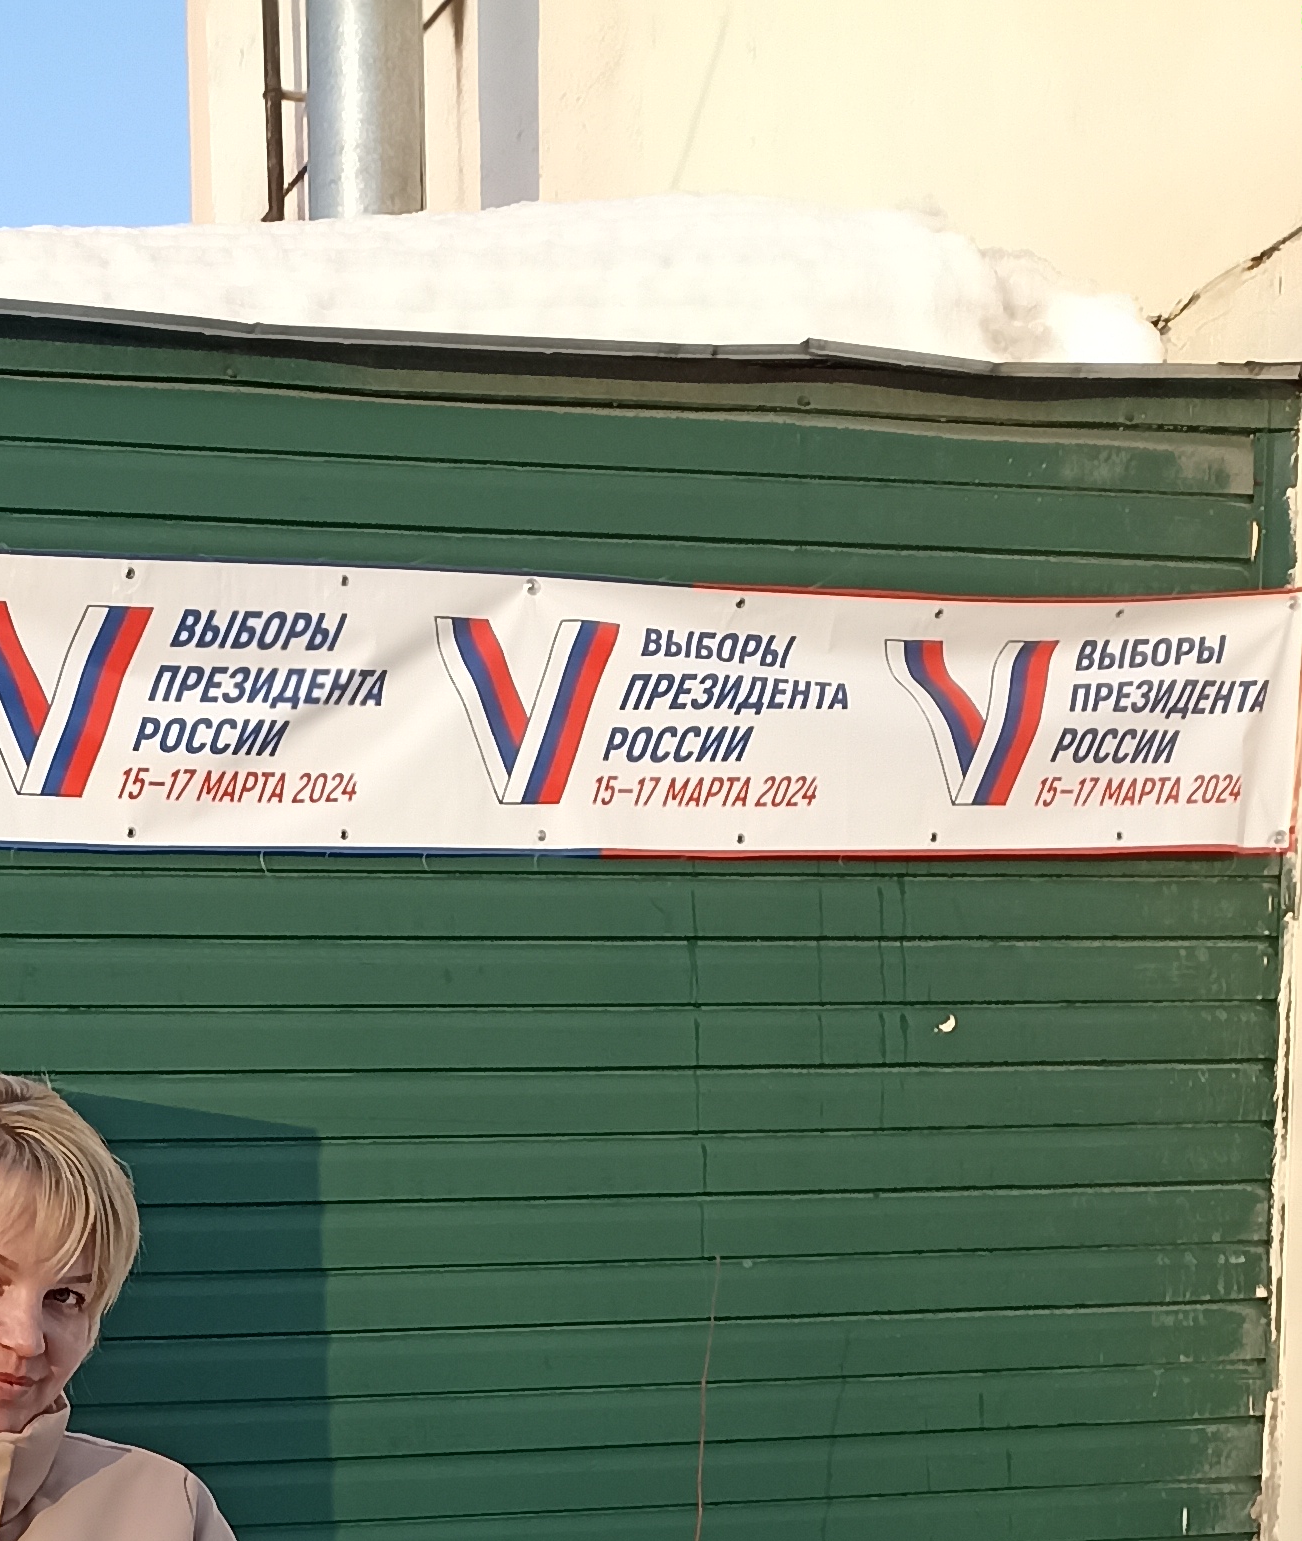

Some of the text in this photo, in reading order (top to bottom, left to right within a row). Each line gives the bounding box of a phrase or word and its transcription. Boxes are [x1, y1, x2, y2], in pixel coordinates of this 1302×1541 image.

[169, 609, 348, 652] ВЫБОРЫ
[640, 627, 798, 668] ВЫБОРЫ
[1074, 634, 1227, 672] ВЫБОРЫ
[148, 665, 389, 709] ПРЕЗИДЕНТА
[619, 674, 849, 713] ПРЕЗИДЕНТА
[1068, 679, 1271, 719] ПРЕЗИДЕНТА
[132, 716, 292, 758] РОССИИ
[602, 725, 756, 764] РОССИИ
[1050, 727, 1181, 764] РОССИИ
[196, 771, 286, 804] МАРТА
[291, 772, 359, 805] 2024
[663, 776, 750, 808] МАРТА
[754, 776, 819, 807] 2024
[1102, 776, 1183, 808] МАРТА
[1186, 773, 1243, 806] 2024
